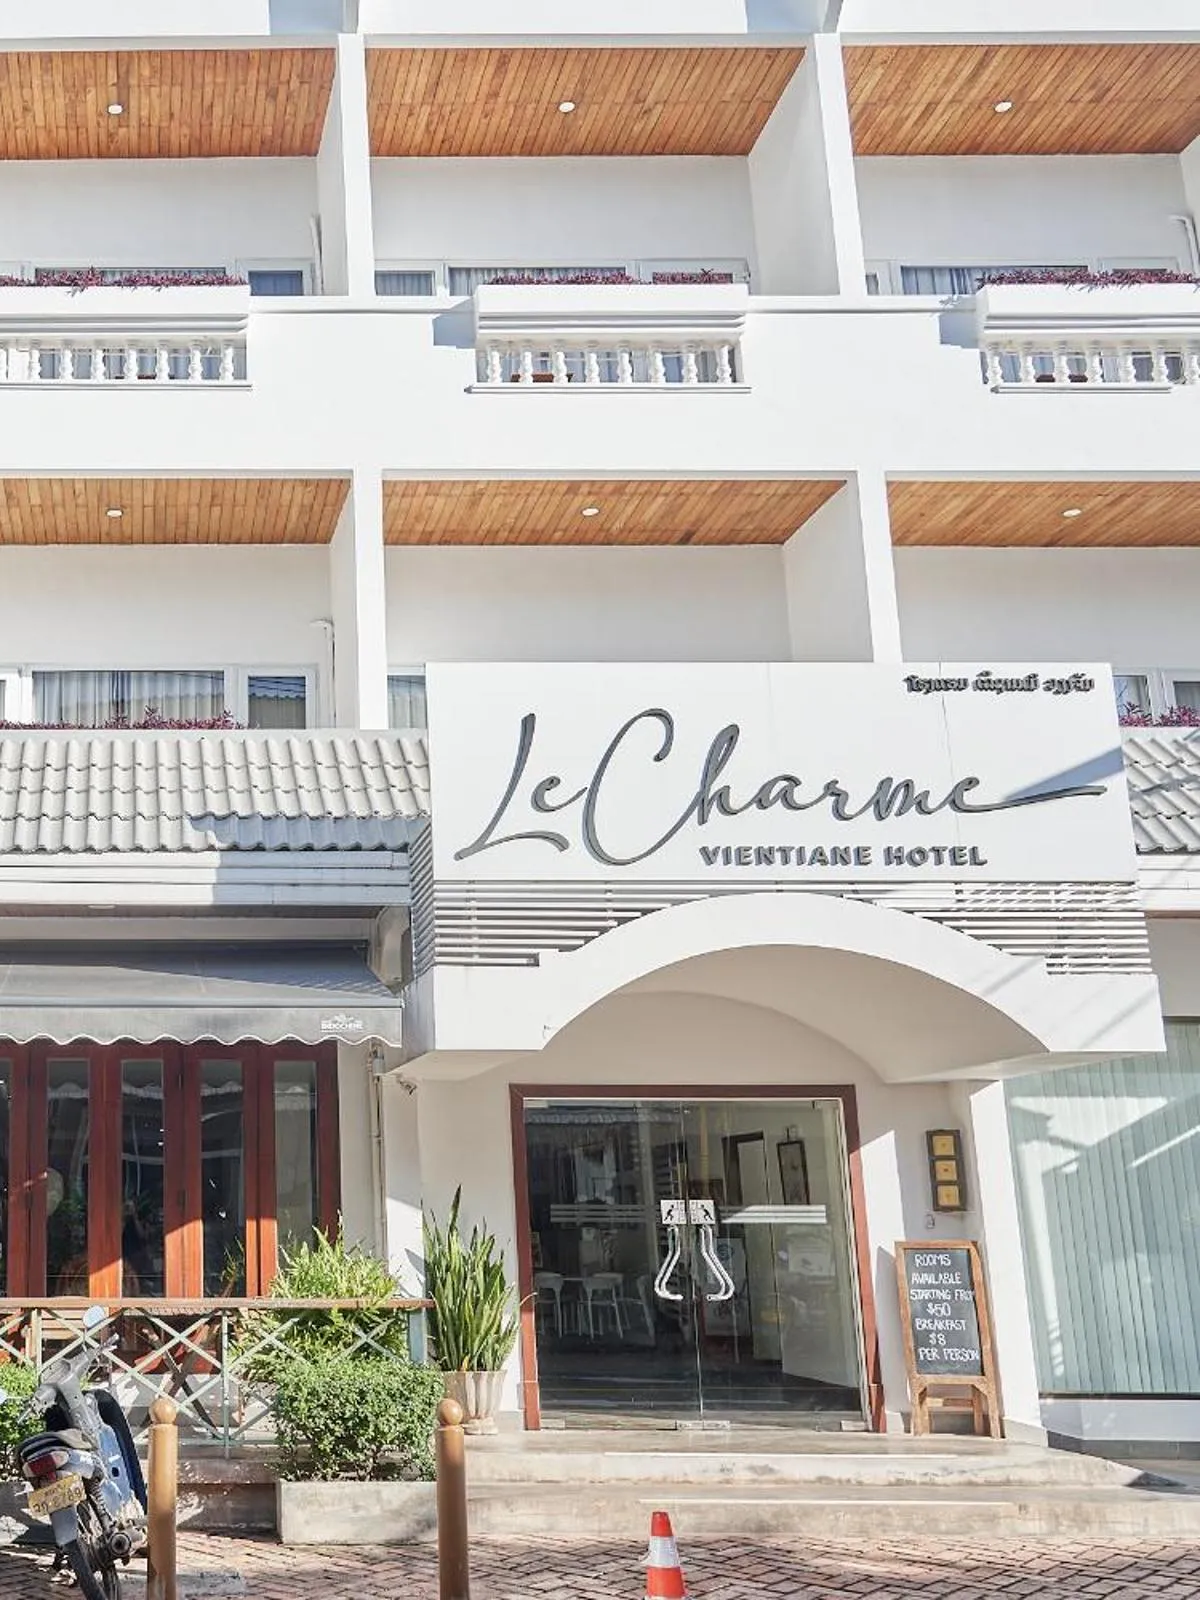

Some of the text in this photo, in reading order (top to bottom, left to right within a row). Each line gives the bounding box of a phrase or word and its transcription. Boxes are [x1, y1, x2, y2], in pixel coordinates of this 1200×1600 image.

[903, 674, 969, 695] ໂຮງແຮມ
[1042, 673, 1095, 695] ວຽງຈັນ
[453, 707, 1107, 866] Le Charme
[700, 845, 988, 868] VIENTIANE HOTEL
[914, 1253, 951, 1268] ROOMS
[911, 1271, 962, 1285] AVAILABLE
[910, 1288, 951, 1301] STARTING
[926, 1302, 951, 1317] $50
[915, 1318, 966, 1331] BREAKFAST
[918, 1347, 979, 1362] PER PERSON
